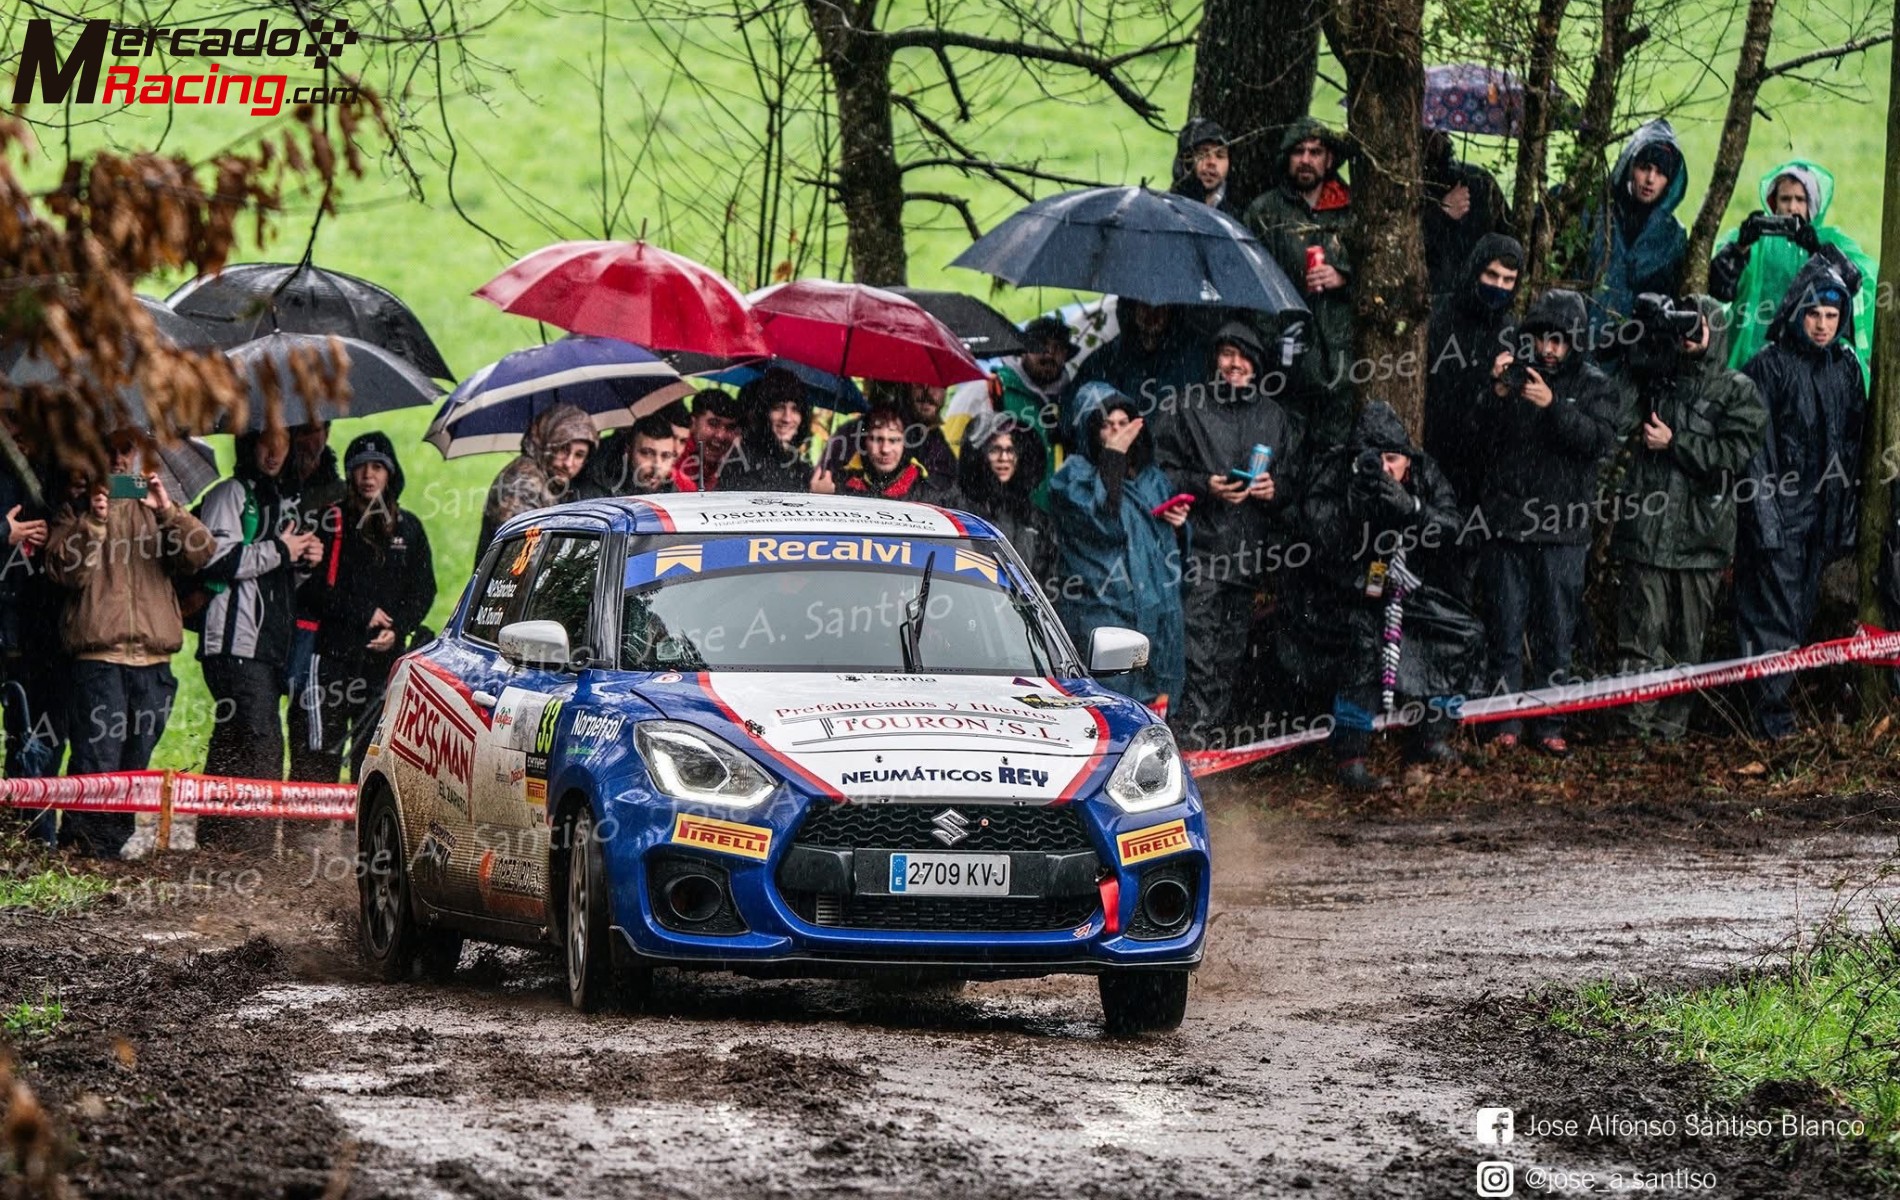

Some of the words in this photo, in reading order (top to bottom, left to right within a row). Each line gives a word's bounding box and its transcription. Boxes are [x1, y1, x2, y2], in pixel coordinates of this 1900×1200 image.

[699, 509, 871, 526] Joserratrans,
[876, 511, 934, 526] S.L.
[748, 538, 912, 565] Recalvi
[776, 701, 937, 718] Prefabricados
[946, 702, 959, 711] y
[969, 702, 1058, 722] Hierros
[537, 698, 564, 753] 33
[570, 709, 628, 742] Norpetrol
[1006, 721, 1071, 743] S.L.
[842, 766, 993, 785] NEUMÁTICOS
[998, 766, 1049, 787] REY
[677, 819, 769, 853] PIRELLI
[1120, 824, 1188, 859] PIRELLI
[895, 876, 902, 886] E
[908, 863, 960, 886] 2709
[967, 863, 1006, 886] KVJ
